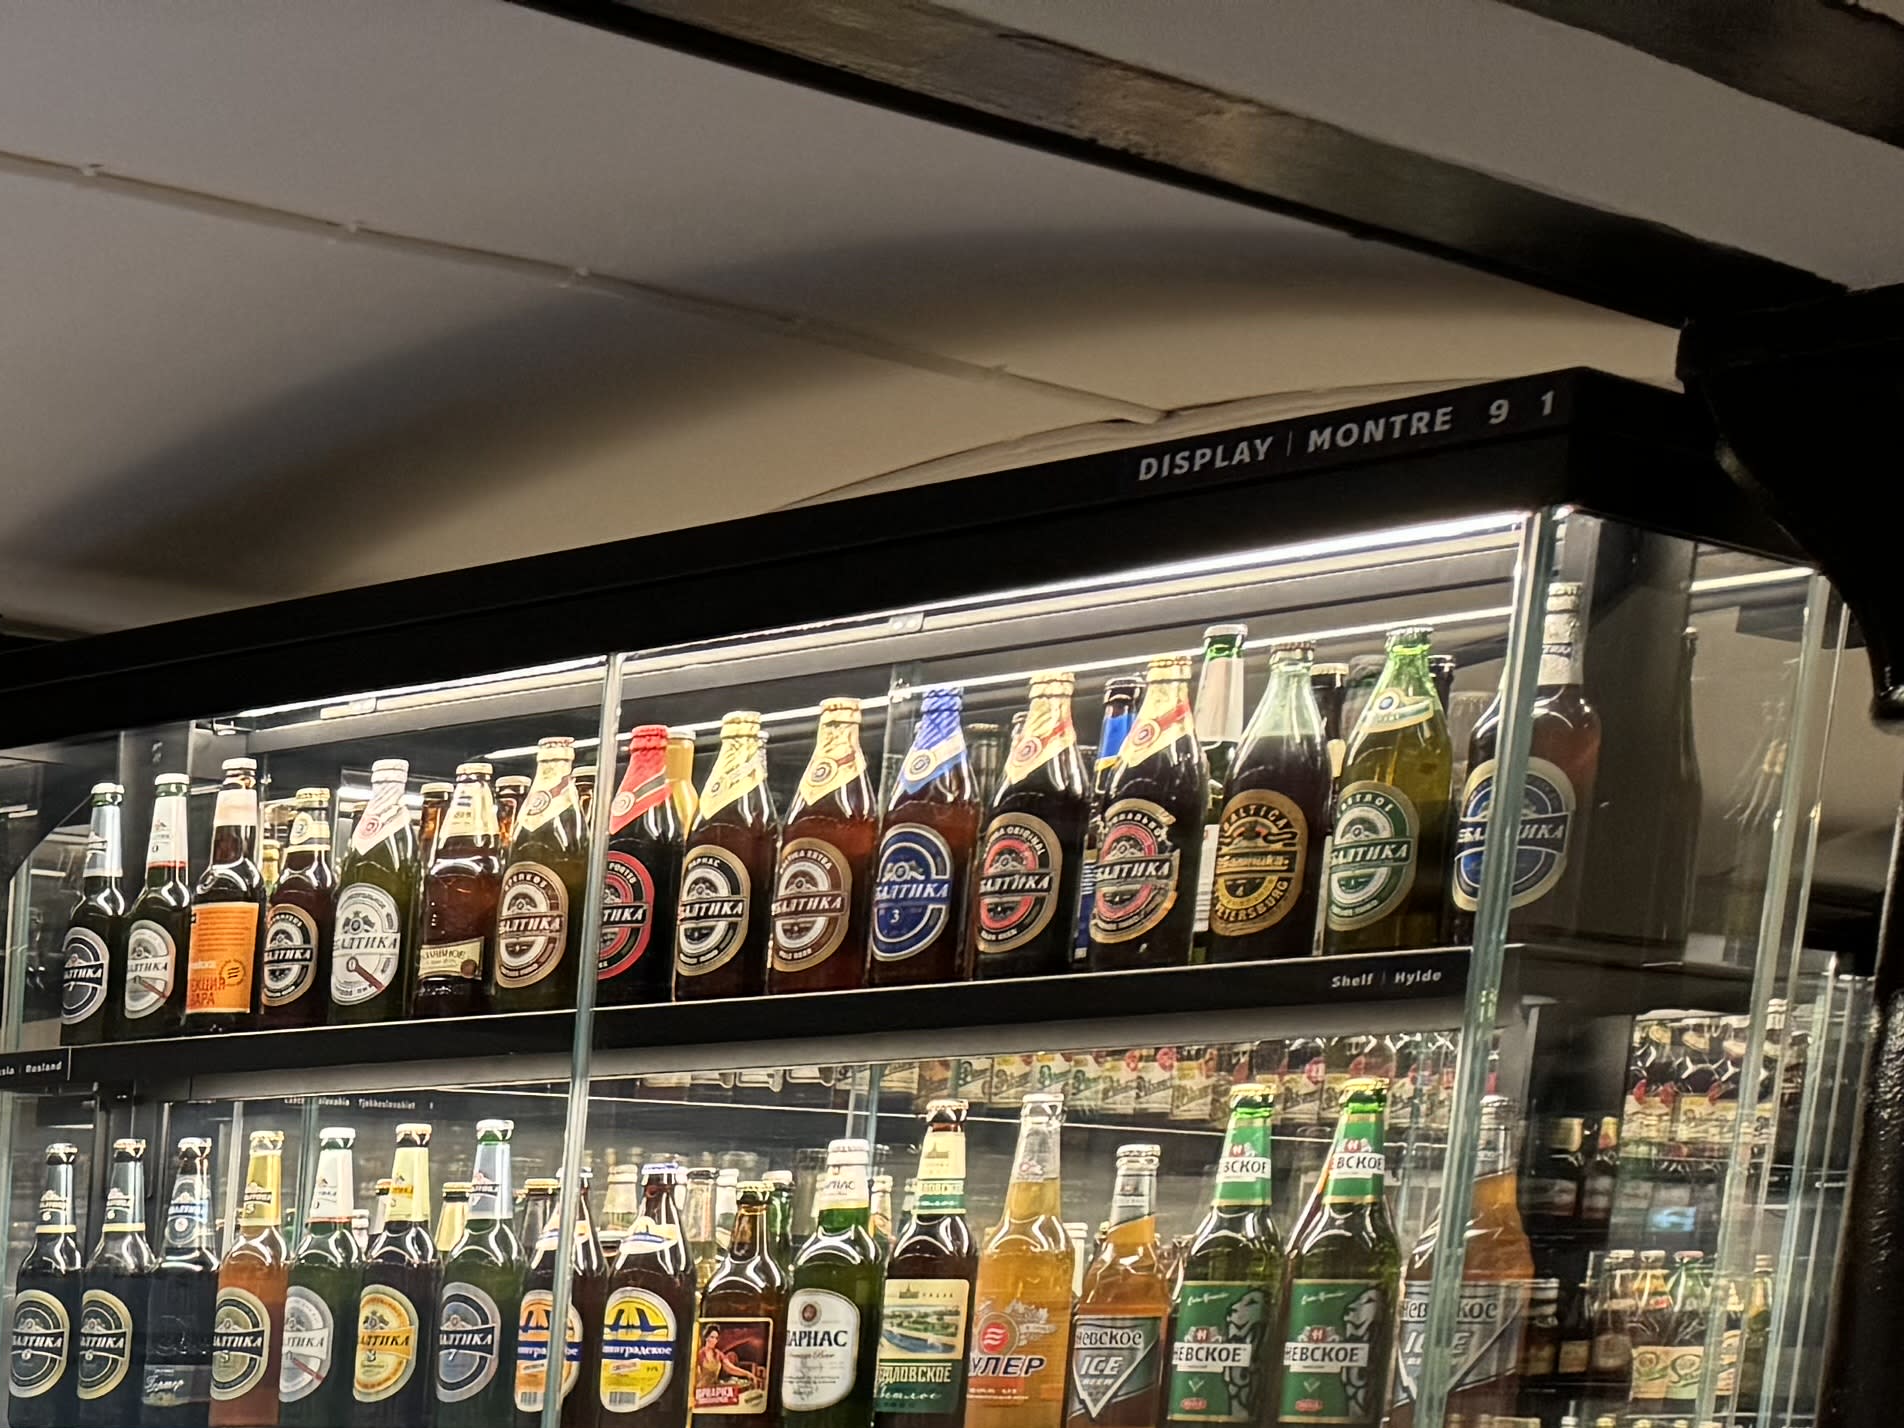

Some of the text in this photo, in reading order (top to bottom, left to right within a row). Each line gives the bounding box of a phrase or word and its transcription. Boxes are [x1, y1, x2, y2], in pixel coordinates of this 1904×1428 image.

[1138, 390, 1554, 481] DISPLAY MONTRE 9 1
[1331, 970, 1442, 989] Shelf Hylde
[968, 1354, 1046, 1378] УЛЕР
[1080, 1356, 1123, 1376] ICE
